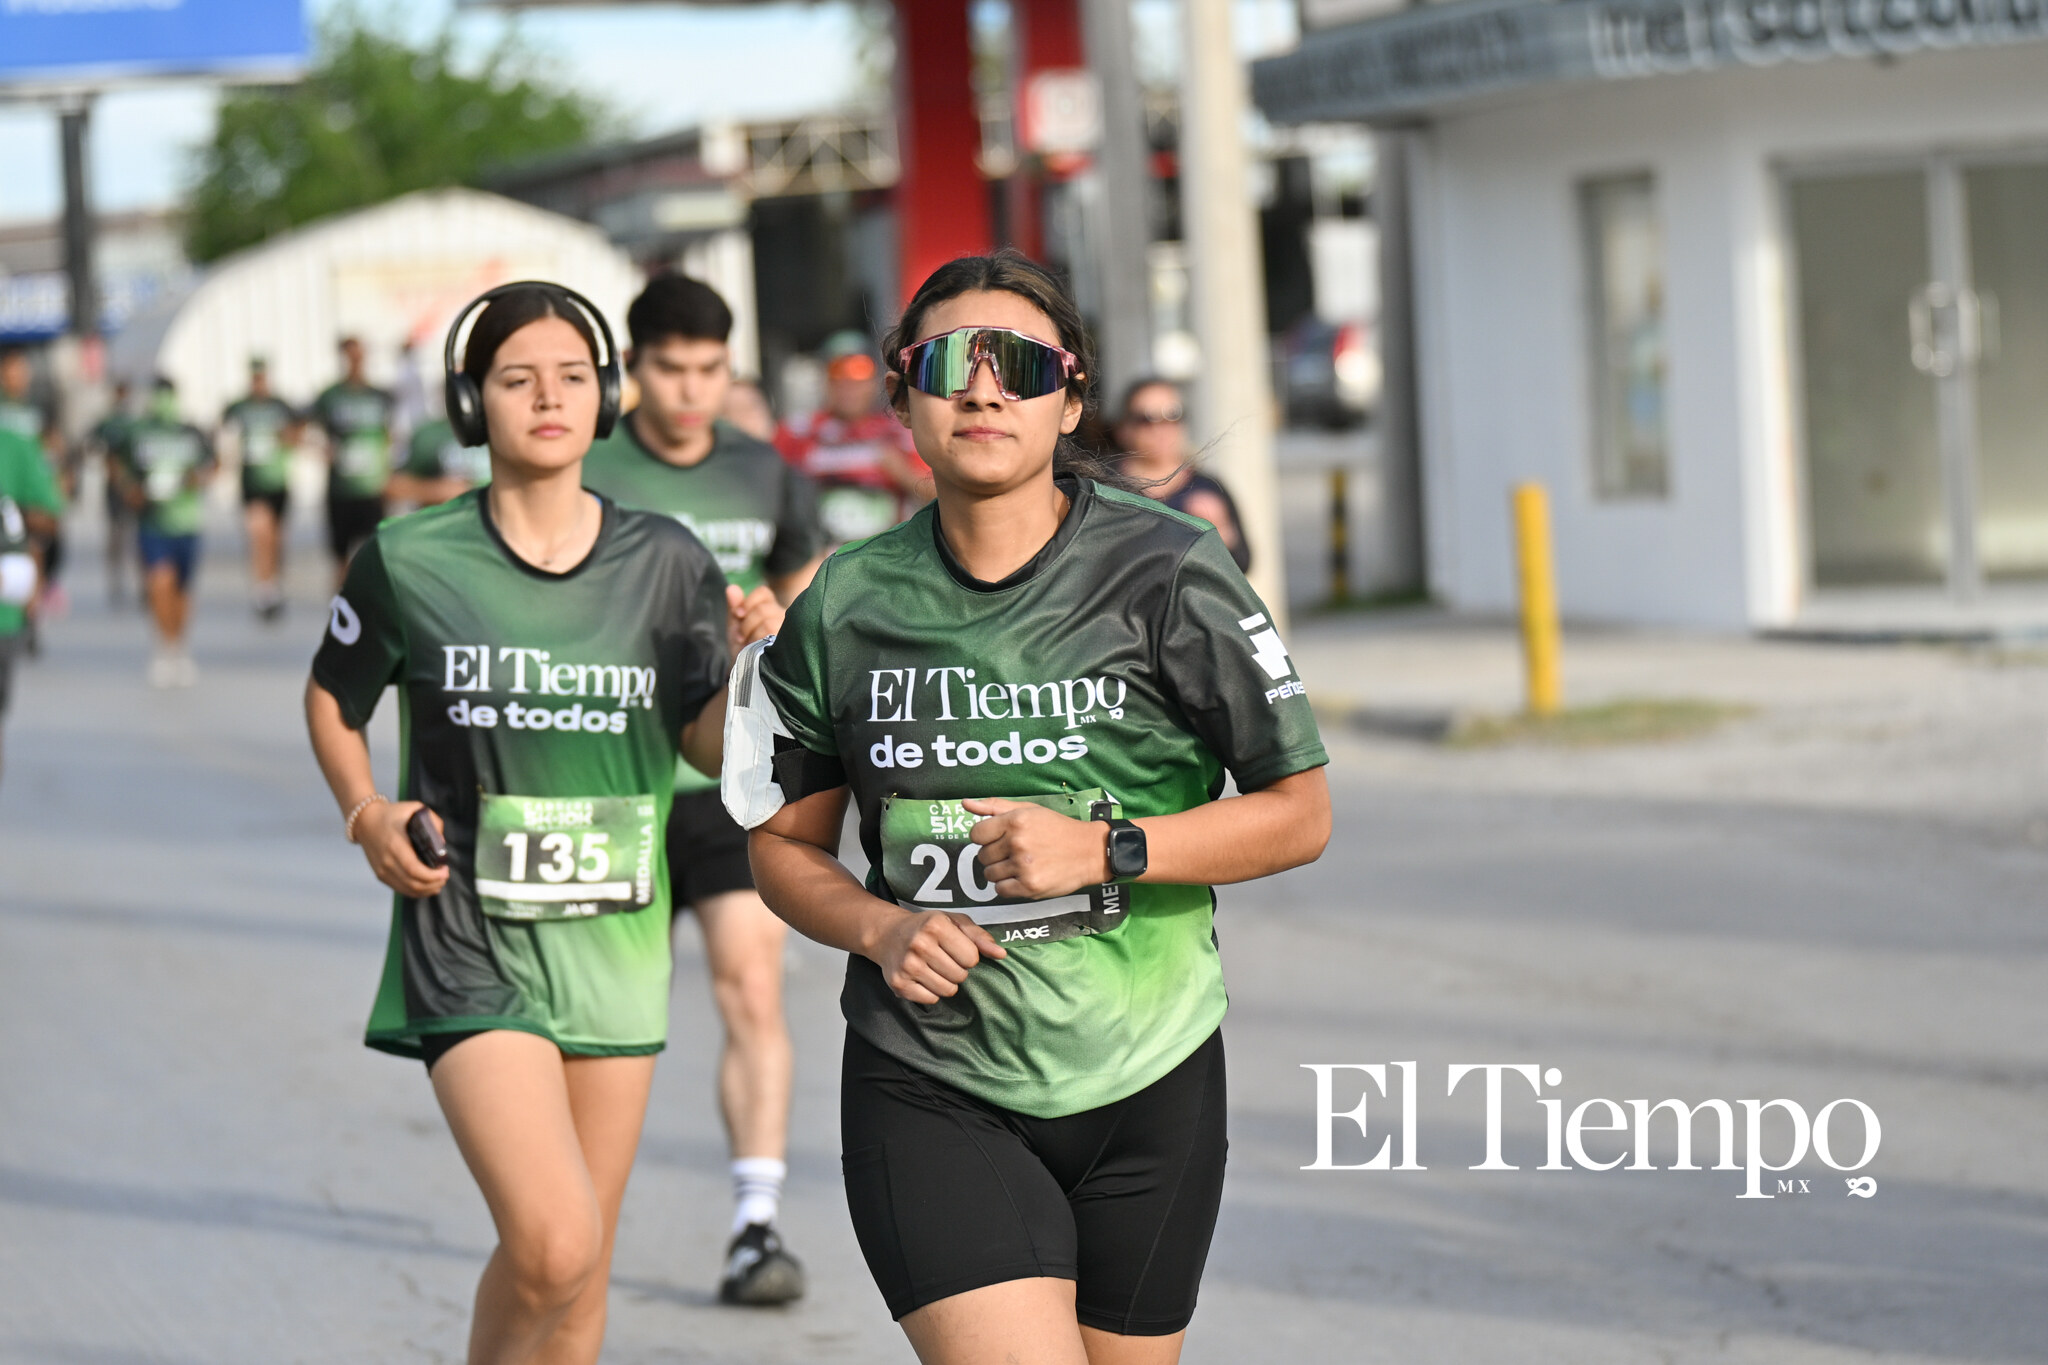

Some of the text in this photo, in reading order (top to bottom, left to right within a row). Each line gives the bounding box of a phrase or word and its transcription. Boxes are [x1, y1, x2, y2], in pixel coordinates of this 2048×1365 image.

[441, 645, 656, 709] El Tiempo
[867, 667, 1127, 730] El Tiempo
[447, 699, 628, 734] de todos
[1080, 715, 1097, 724] MX
[870, 731, 1090, 768] de todos
[503, 832, 610, 883] 135
